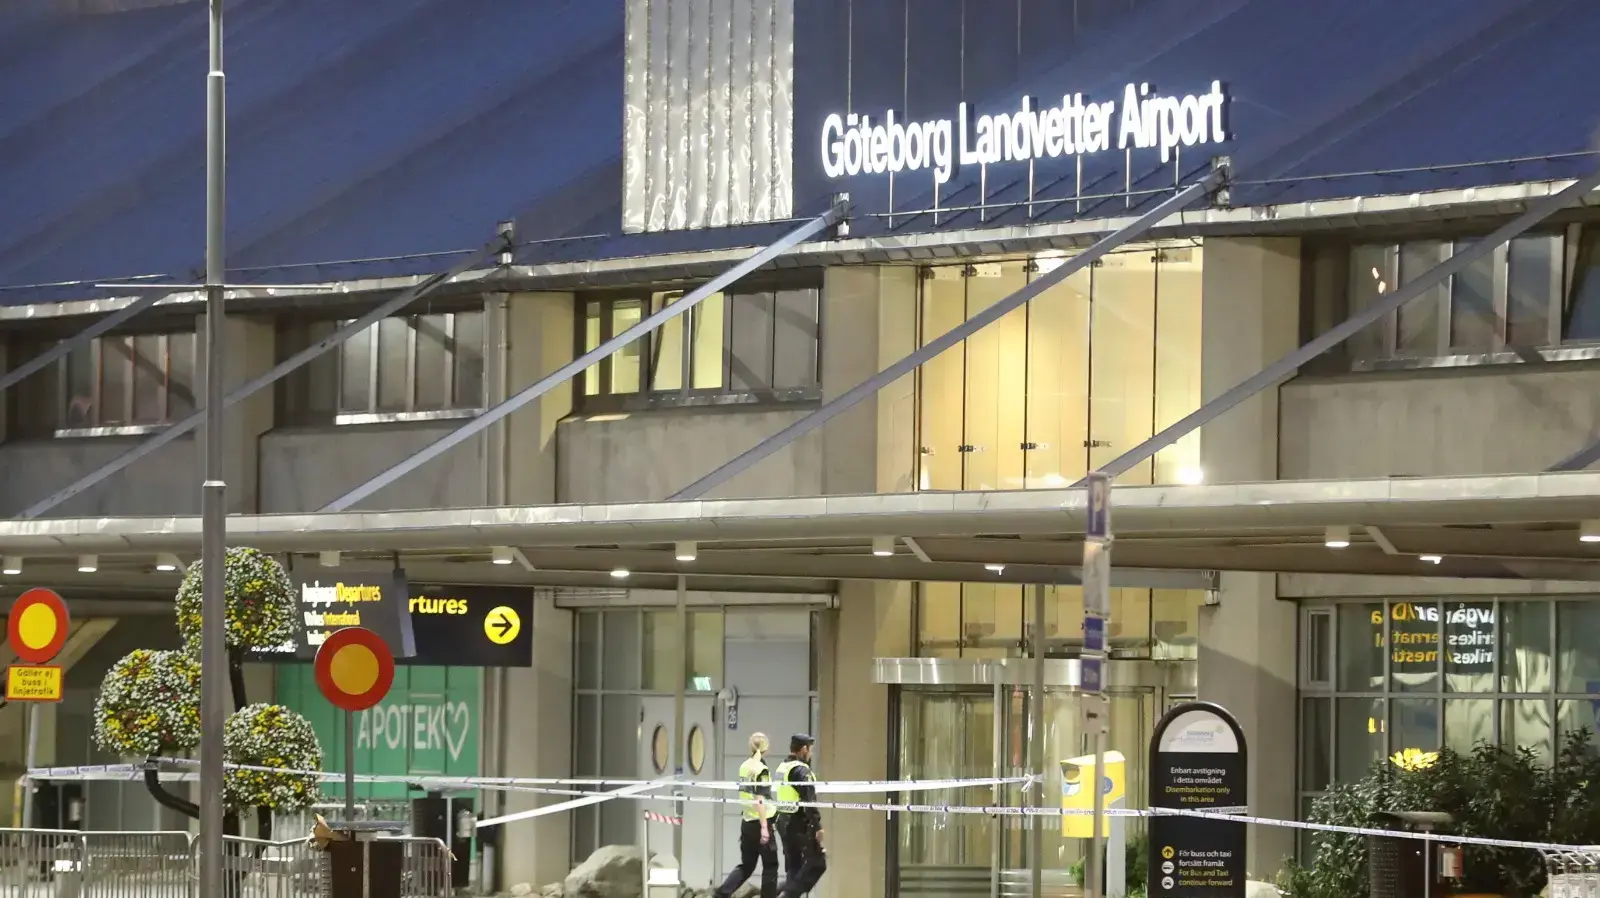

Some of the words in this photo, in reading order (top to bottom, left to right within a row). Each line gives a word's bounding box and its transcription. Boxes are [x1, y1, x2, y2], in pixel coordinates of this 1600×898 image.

[821, 109, 953, 183] Göteborg
[959, 92, 1114, 165] Landvetter
[1118, 80, 1225, 163] Airport
[409, 595, 468, 615] rtures
[357, 703, 441, 750] APOTEK
[1193, 767, 1226, 776] avstigning
[1216, 786, 1231, 794] only
